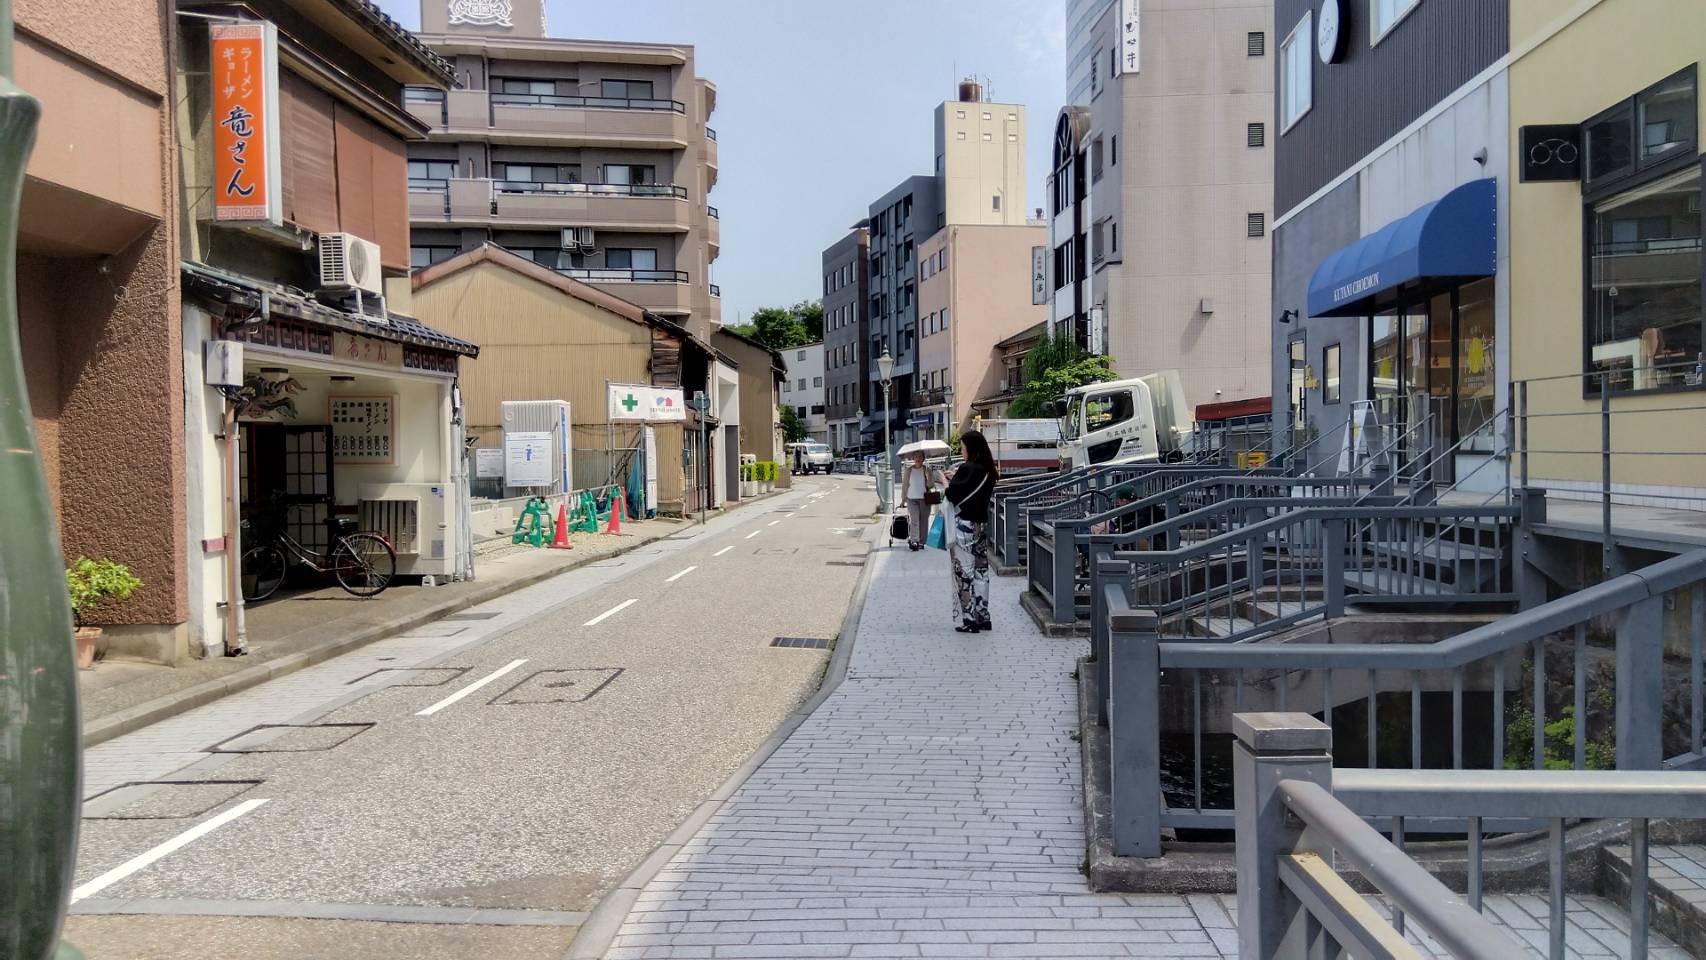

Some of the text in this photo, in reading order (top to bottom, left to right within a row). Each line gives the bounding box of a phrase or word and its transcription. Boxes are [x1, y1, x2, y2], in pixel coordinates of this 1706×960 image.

[223, 47, 236, 99] ギョーザ
[240, 47, 253, 99] ラーメン
[221, 105, 255, 196] 竜さん
[1334, 271, 1380, 302] KUTANI CHOEMON
